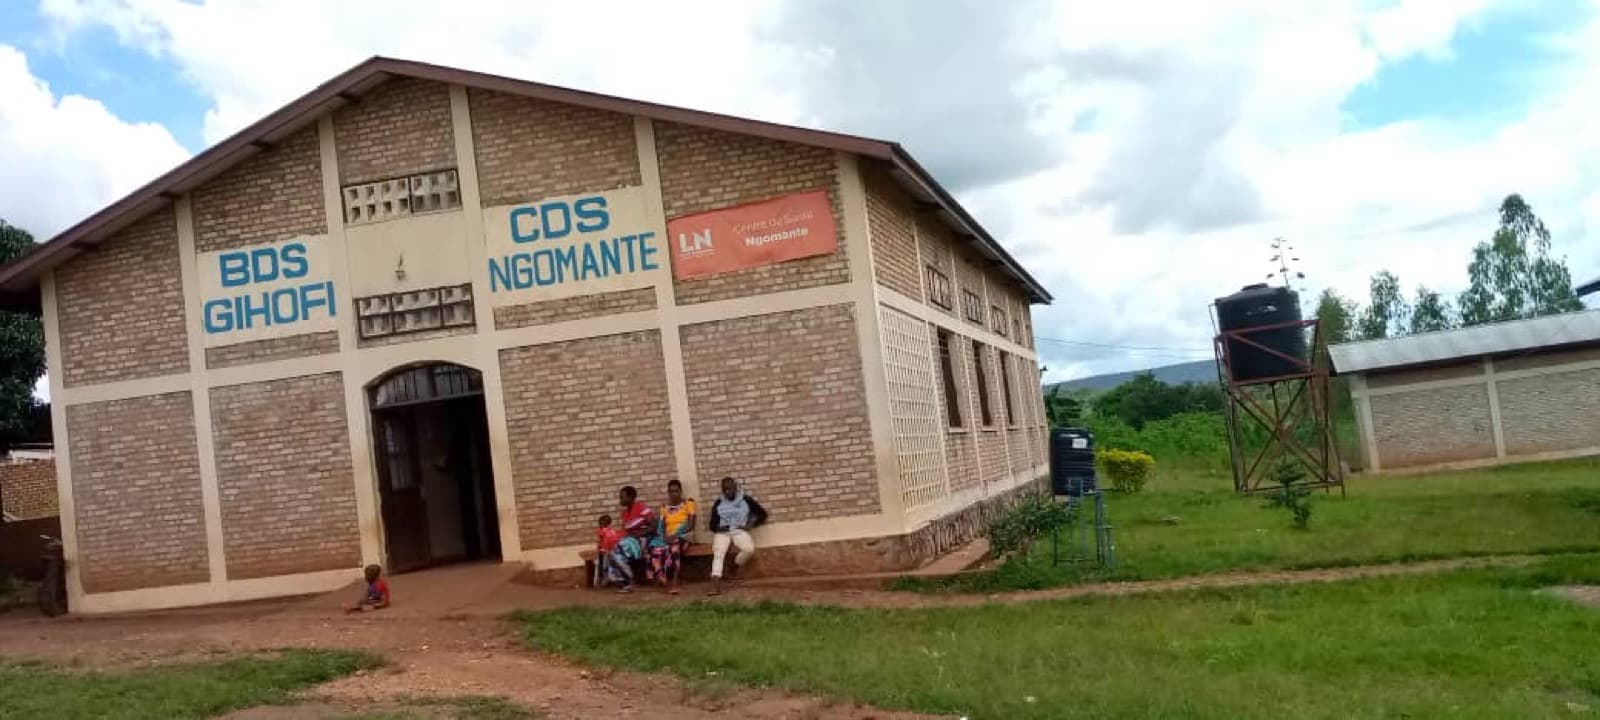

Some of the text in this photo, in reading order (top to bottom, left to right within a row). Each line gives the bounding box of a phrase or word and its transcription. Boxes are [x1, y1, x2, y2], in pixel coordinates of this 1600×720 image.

[510, 196, 610, 244] CDS
[744, 226, 809, 248] Ngomante
[219, 243, 309, 288] BDS
[489, 231, 658, 293] NGOMANTE
[203, 281, 337, 335] GIHOFI
